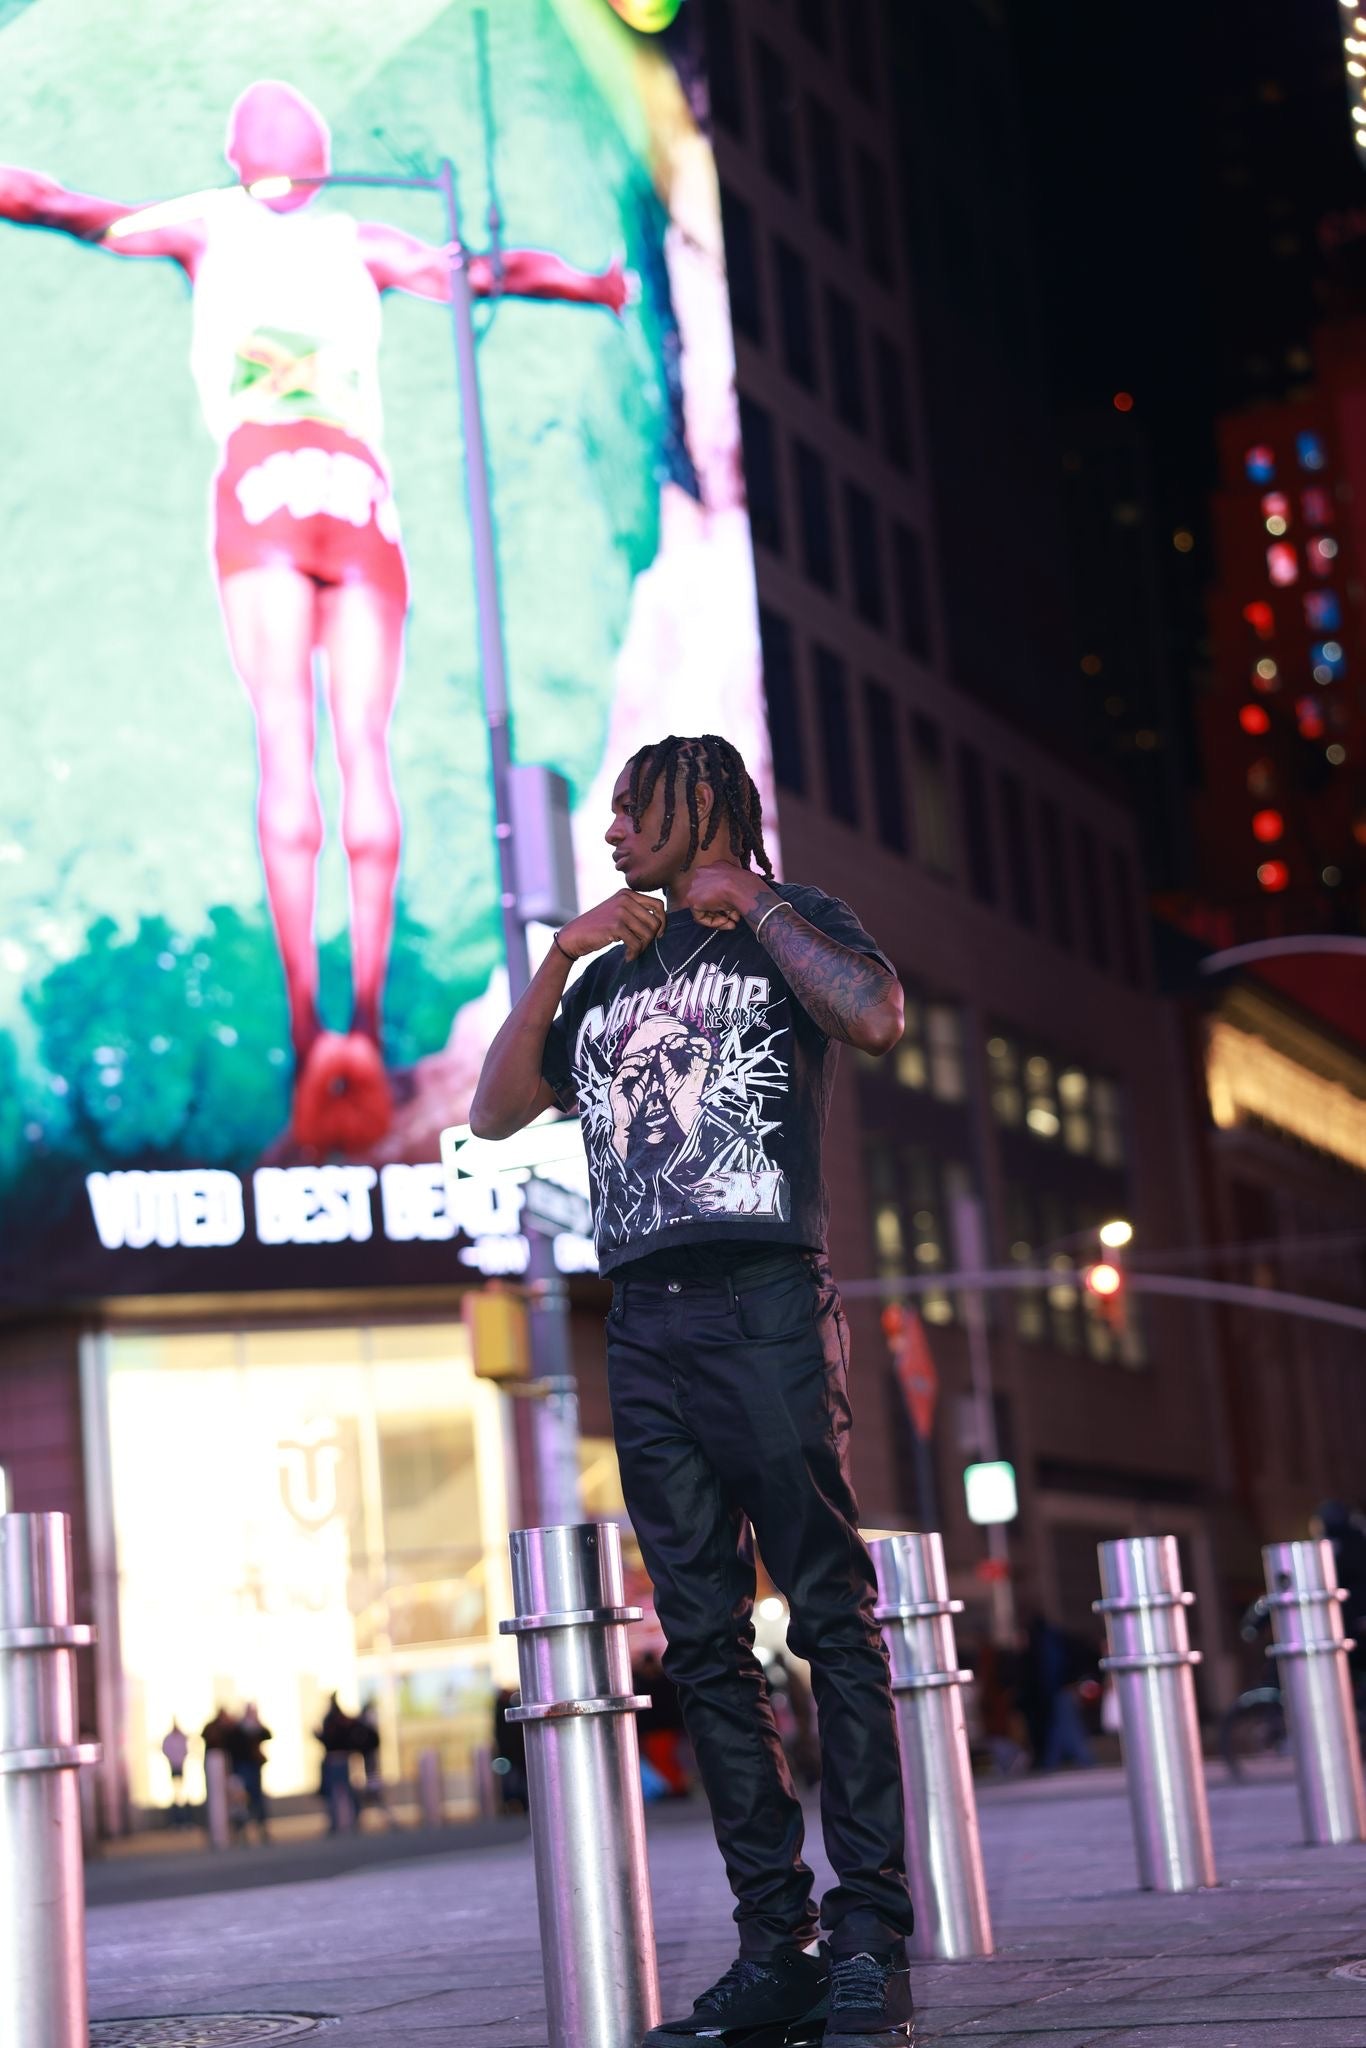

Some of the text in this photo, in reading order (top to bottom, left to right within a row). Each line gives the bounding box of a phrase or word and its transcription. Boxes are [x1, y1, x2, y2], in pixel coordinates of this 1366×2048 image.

[704, 1007, 771, 1029] RECORDS
[86, 1168, 245, 1249] VOTED
[253, 1164, 377, 1245] BEST
